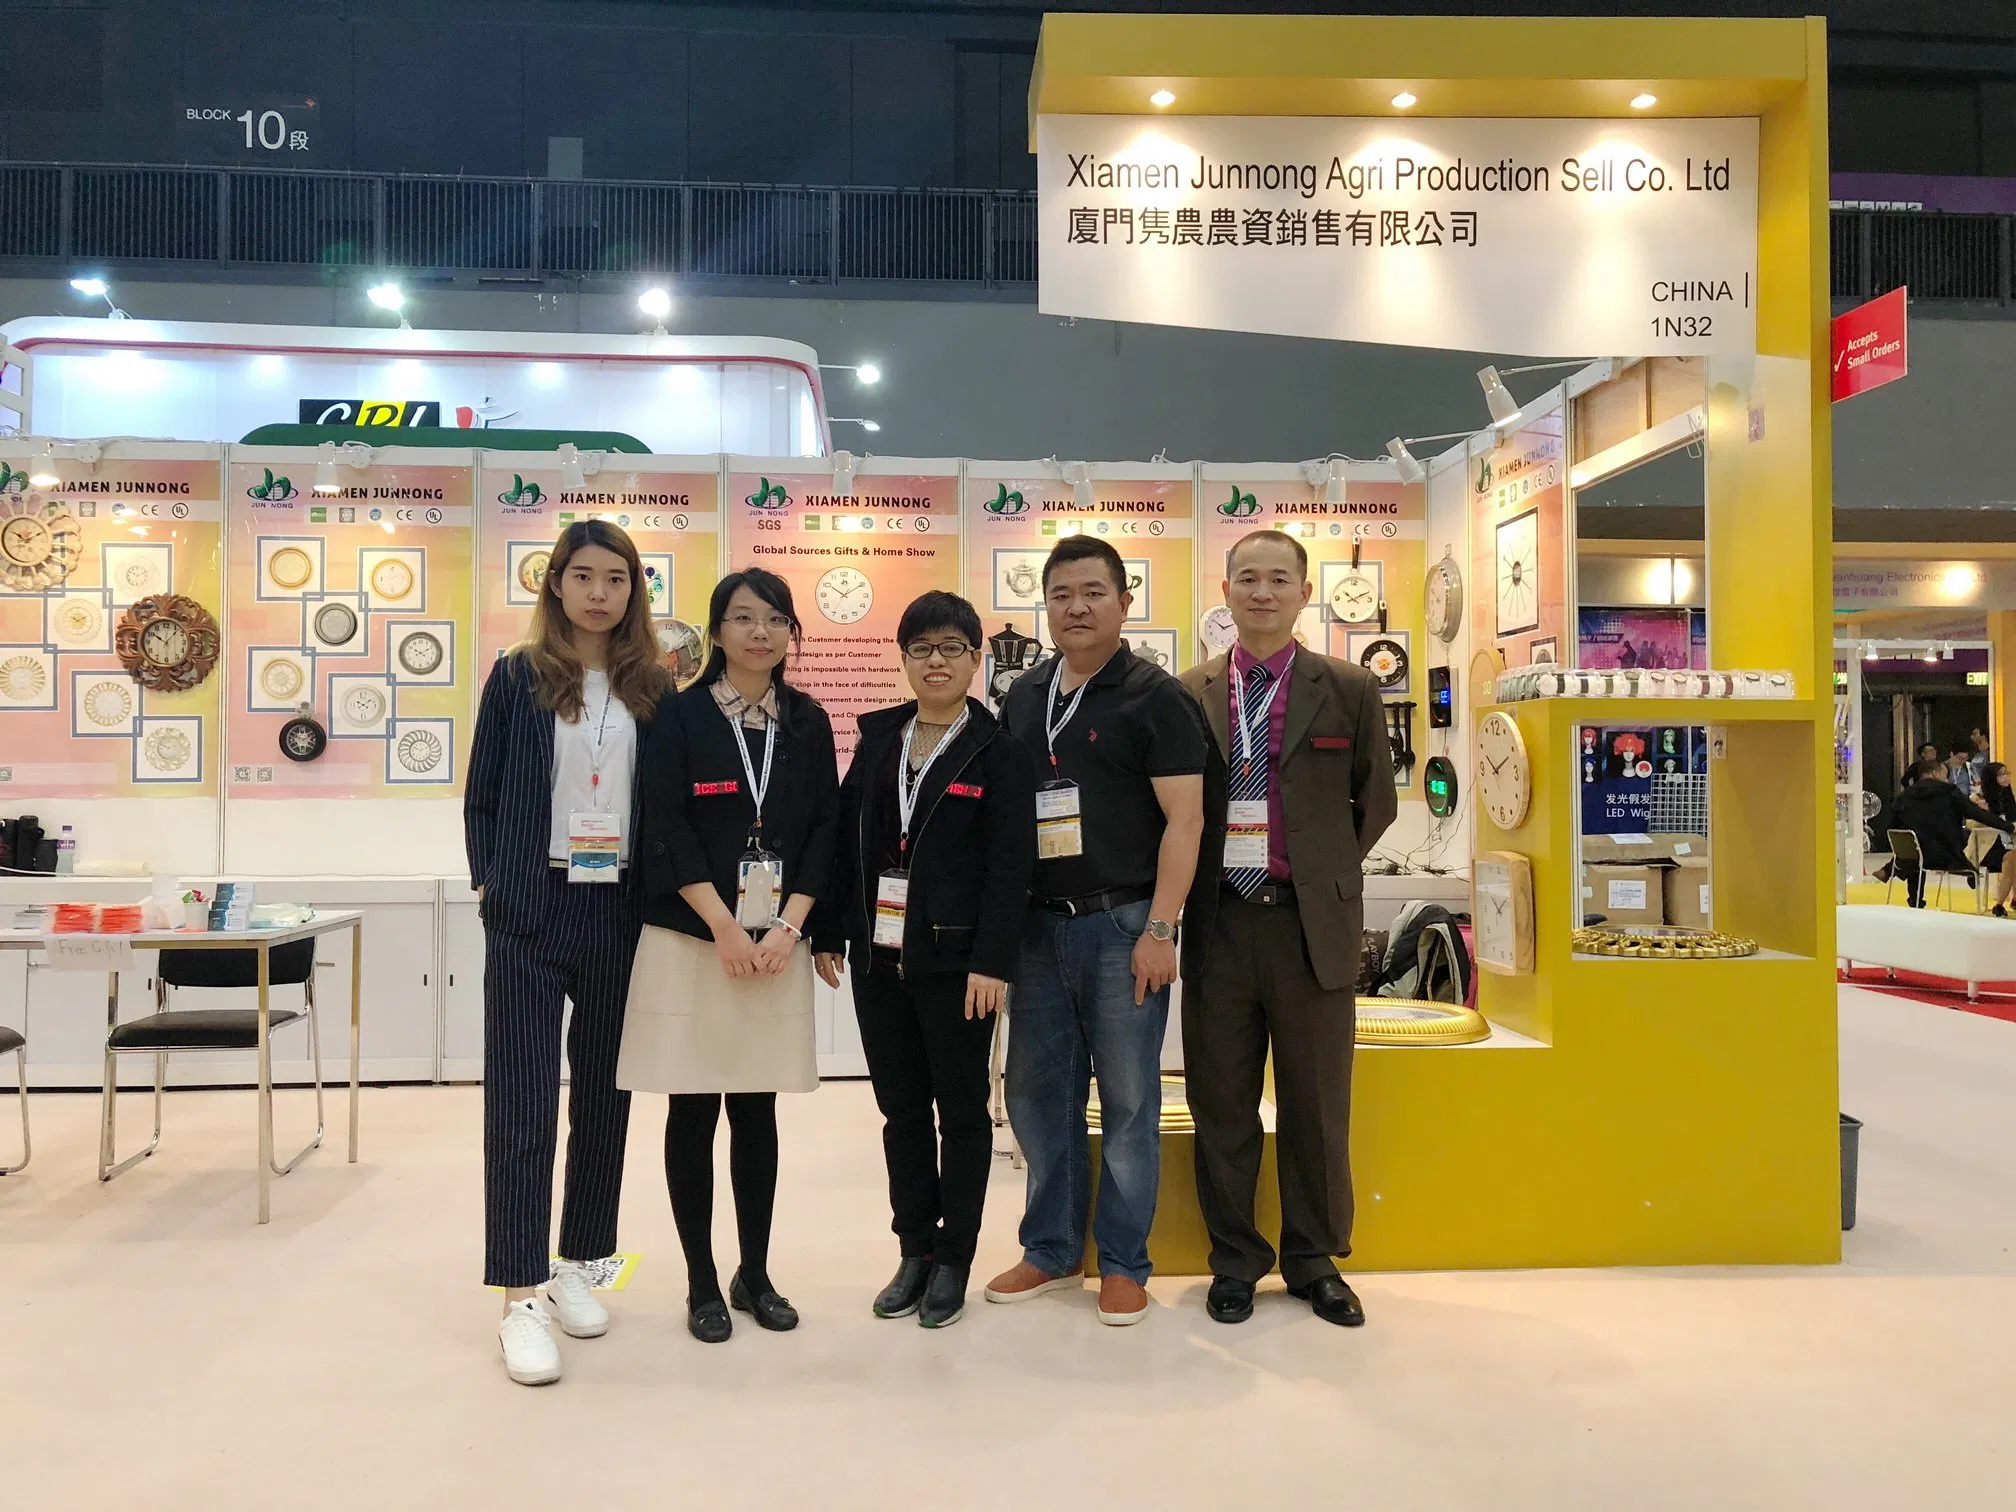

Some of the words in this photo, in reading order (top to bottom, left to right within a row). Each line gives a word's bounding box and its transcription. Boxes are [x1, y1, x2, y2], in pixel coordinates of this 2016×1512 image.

[186, 108, 232, 121] BLOCK
[236, 109, 286, 150] 10
[288, 130, 309, 151] 段
[1066, 153, 1179, 189] Xiamen
[1190, 155, 1318, 199] Junnong
[1325, 156, 1384, 200] Agri
[1395, 157, 1550, 192] Production
[1560, 157, 1613, 192] Sell
[1625, 158, 1674, 192] Co.
[1685, 157, 1731, 191] Ltd
[1651, 280, 1734, 302] CHINA
[1651, 316, 1712, 337] 1N32
[1847, 330, 1879, 352] Accepts
[1847, 348, 1871, 370] Small
[1872, 340, 1900, 359] Orders
[1498, 457, 1522, 481] XIAMEN
[1523, 439, 1555, 468] JUNNONG
[51, 481, 110, 493] XIAMEN
[115, 481, 190, 494] JUNNONG
[372, 487, 443, 500] JUNNONG
[559, 492, 616, 505] XIAMEN
[621, 493, 689, 506] JUNNONG
[805, 495, 860, 507] XIAMEN
[864, 496, 931, 509] JUNNONG
[1099, 501, 1165, 513] JUNNONG
[1275, 502, 1328, 514] XIAMEN
[1332, 502, 1398, 514] JUNNONG
[757, 519, 782, 531] SGS
[752, 545, 787, 555] Global
[790, 546, 831, 556] Sources
[834, 546, 859, 556] Gifts
[861, 547, 870, 556] &
[873, 547, 903, 557] Home
[906, 547, 936, 557] Show
[843, 636, 881, 645] developing
[801, 651, 824, 659] design
[1491, 720, 1500, 736] 12
[1480, 760, 1484, 776] 9
[1513, 764, 1519, 781] 3
[1500, 806, 1505, 822] 6
[1606, 807, 1625, 818] LED
[1630, 807, 1650, 820] Wig
